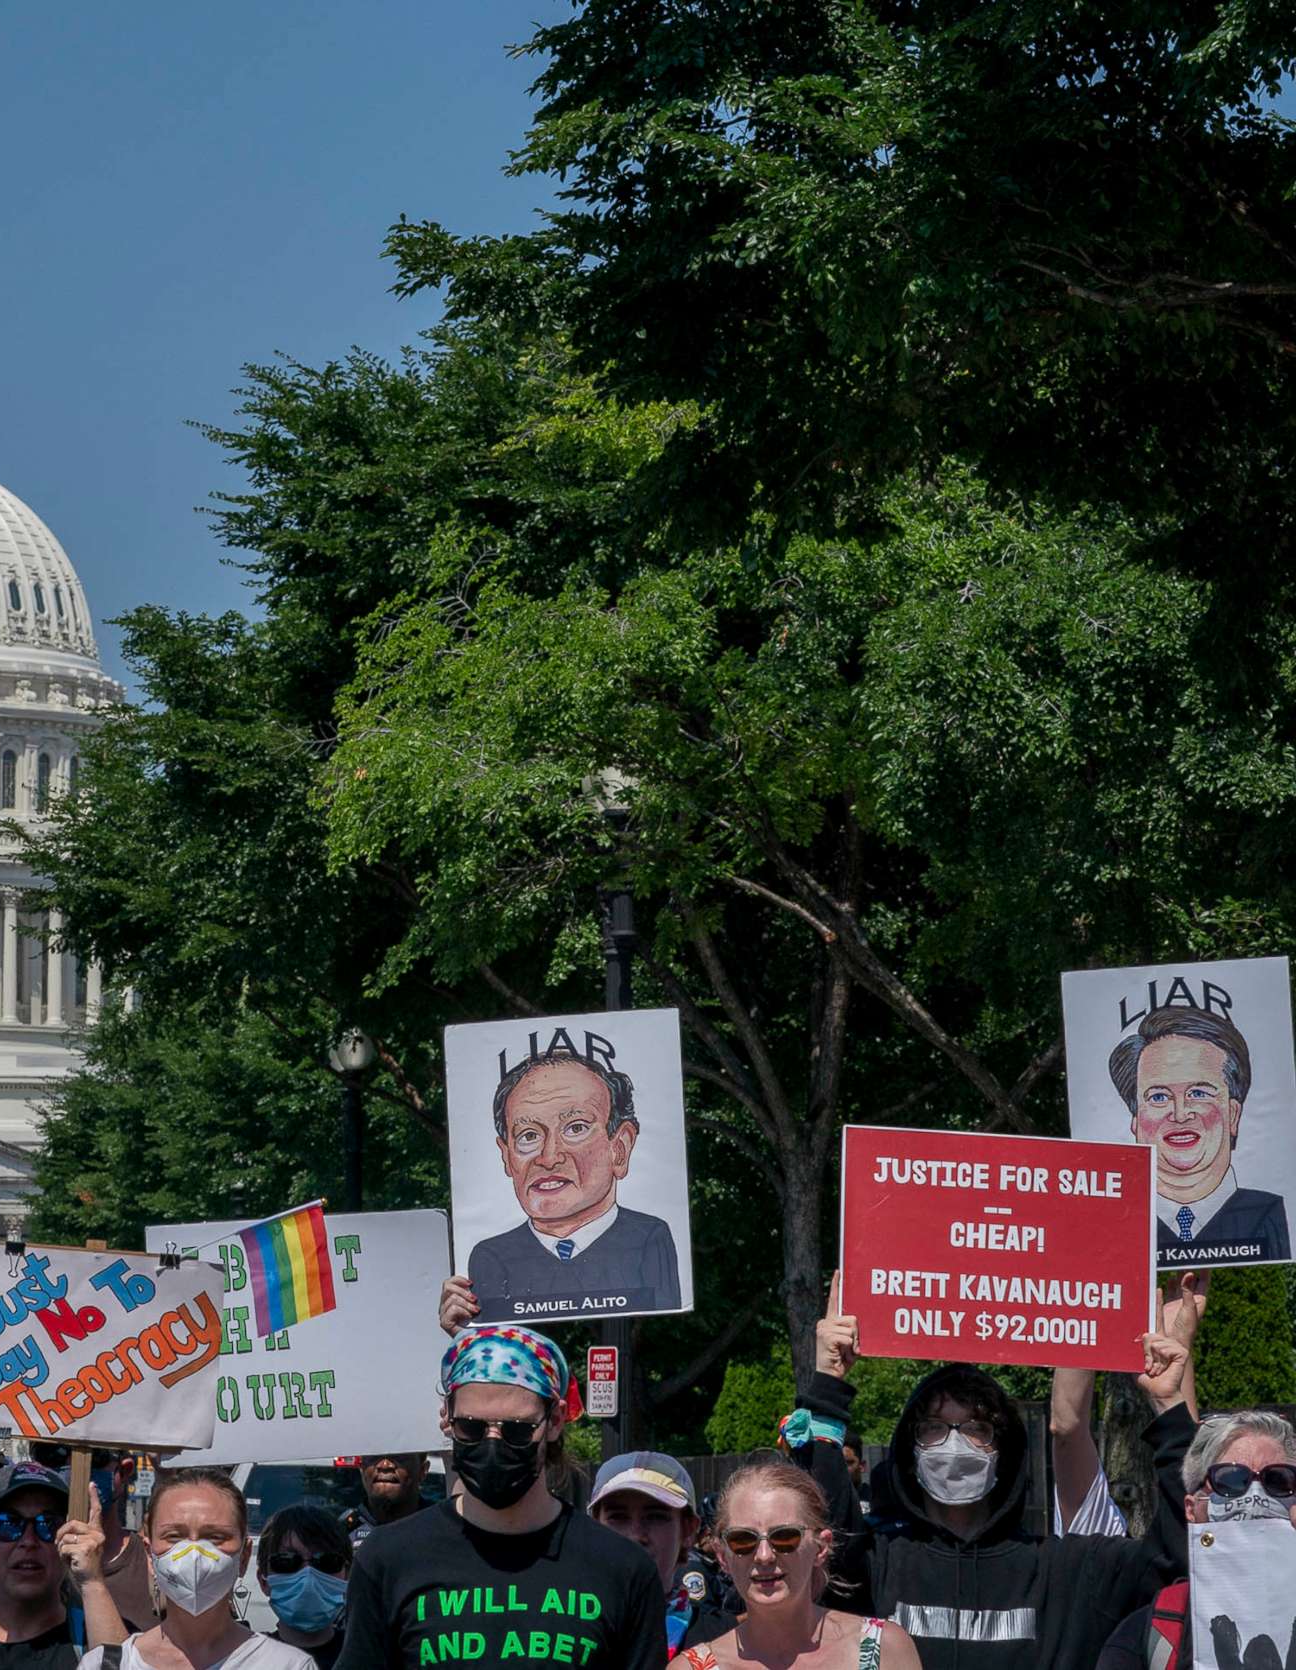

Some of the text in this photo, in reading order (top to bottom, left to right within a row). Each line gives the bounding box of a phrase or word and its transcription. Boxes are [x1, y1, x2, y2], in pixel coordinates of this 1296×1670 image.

[1119, 977, 1234, 1032] LIAR
[498, 1028, 616, 1082] LIAR
[873, 1157, 1122, 1198] JUSTICE FOR SALE
[950, 1222, 1045, 1253] CHEAP!
[1166, 1245, 1261, 1261] KAVANAUGH
[35, 1298, 107, 1353] No
[89, 1258, 156, 1313] To
[513, 1296, 627, 1315] SAMUEL ALITO
[871, 1269, 1122, 1310] BRETT KAVANAUGH
[894, 1308, 1097, 1346] ONLY $92,000!!
[591, 1362, 614, 1371] PARKING
[215, 1370, 336, 1423] OURT
[592, 1383, 613, 1393] SCUS
[417, 1585, 602, 1622] I WILL AID
[420, 1631, 598, 1666] AND ABET
